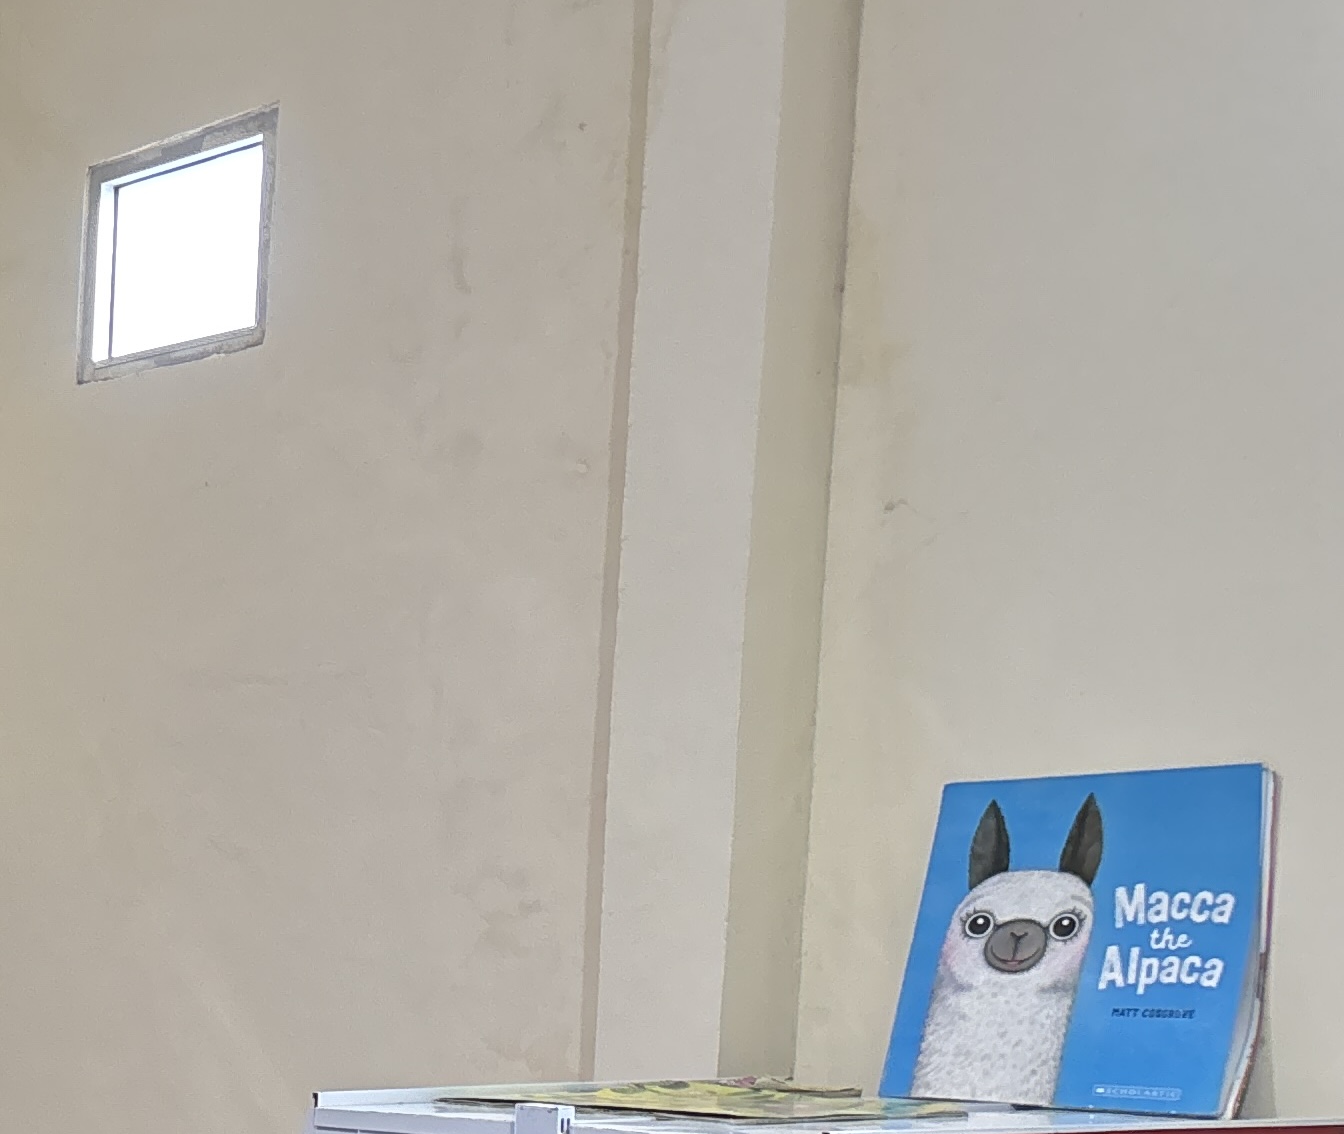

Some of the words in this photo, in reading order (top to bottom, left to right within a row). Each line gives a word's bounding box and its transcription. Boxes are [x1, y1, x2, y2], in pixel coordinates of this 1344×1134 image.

[1114, 884, 1235, 928] Macca
[1150, 927, 1193, 950] the
[1098, 946, 1224, 995] Alpaca
[1111, 1008, 1140, 1018] MATT
[1141, 1008, 1196, 1019] COSGROVE
